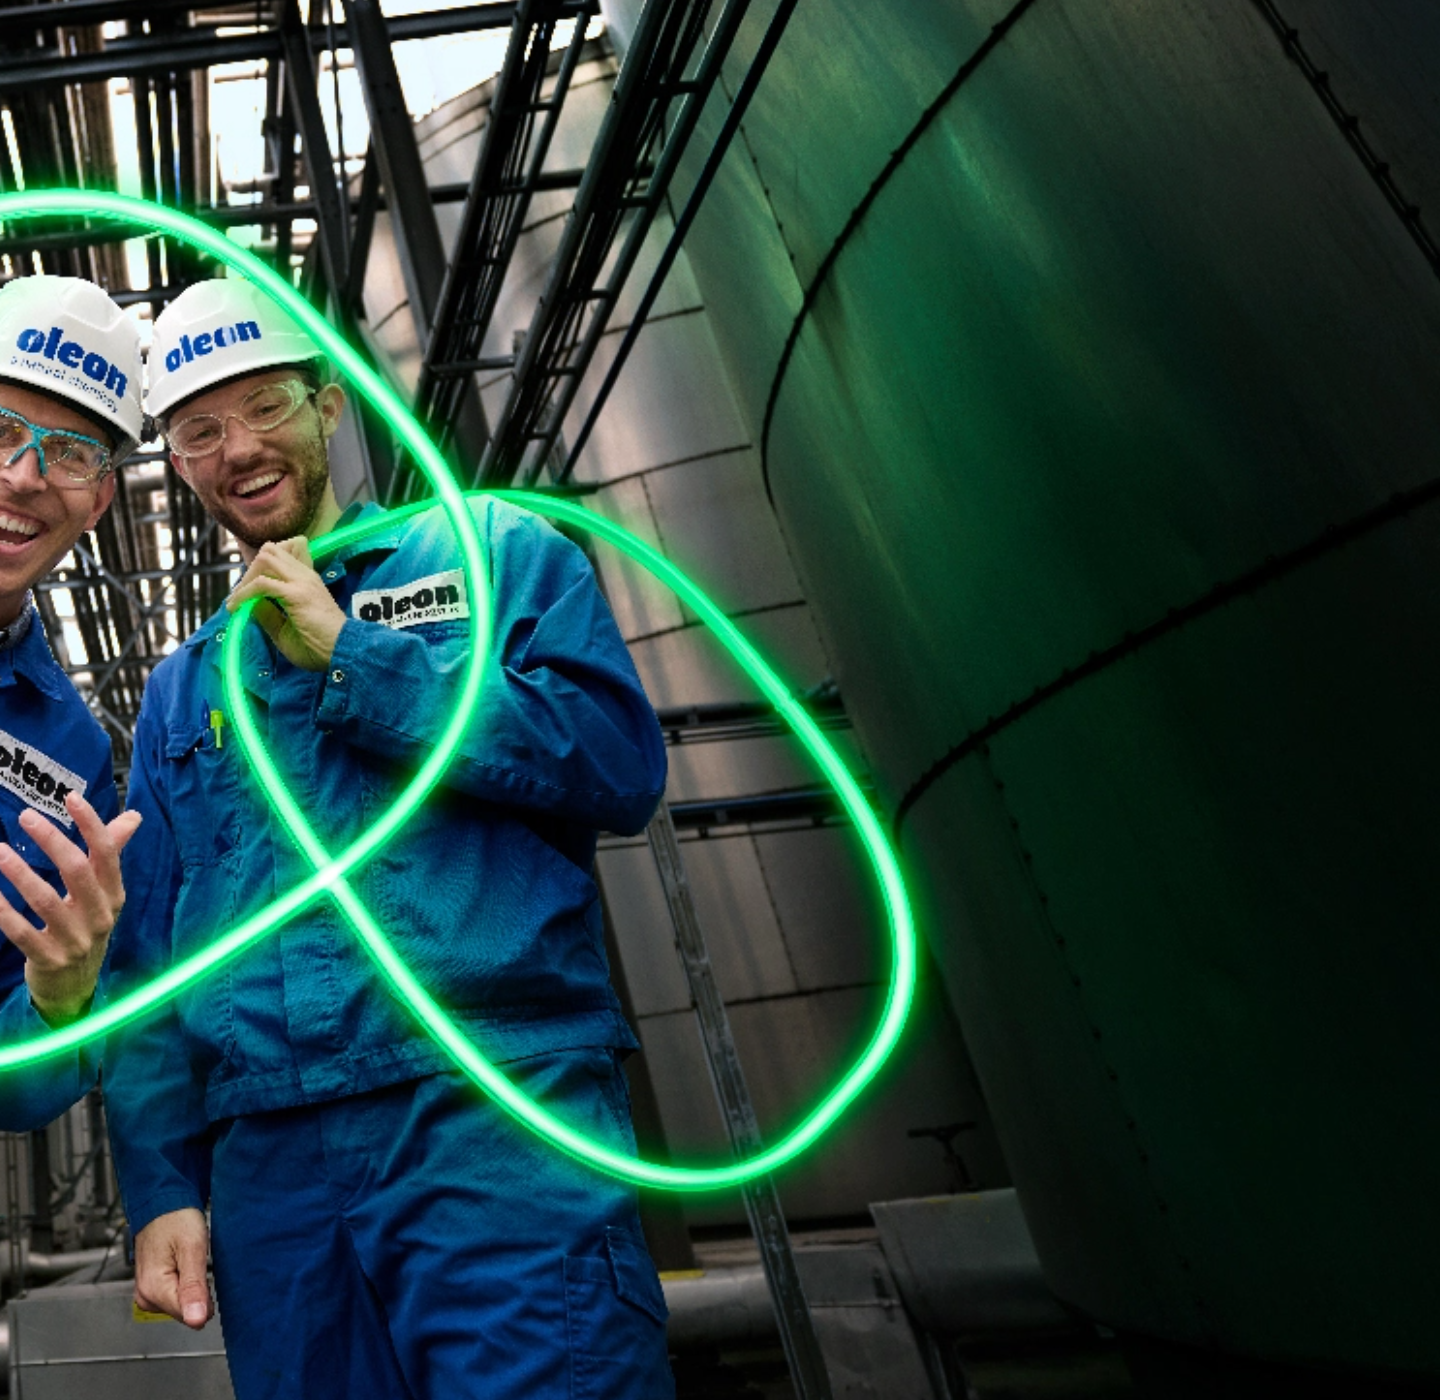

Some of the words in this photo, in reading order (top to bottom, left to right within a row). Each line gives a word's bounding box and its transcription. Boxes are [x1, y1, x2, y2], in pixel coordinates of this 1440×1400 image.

[16, 327, 128, 399] oleon
[165, 321, 262, 372] oleon
[360, 584, 459, 622] oleon
